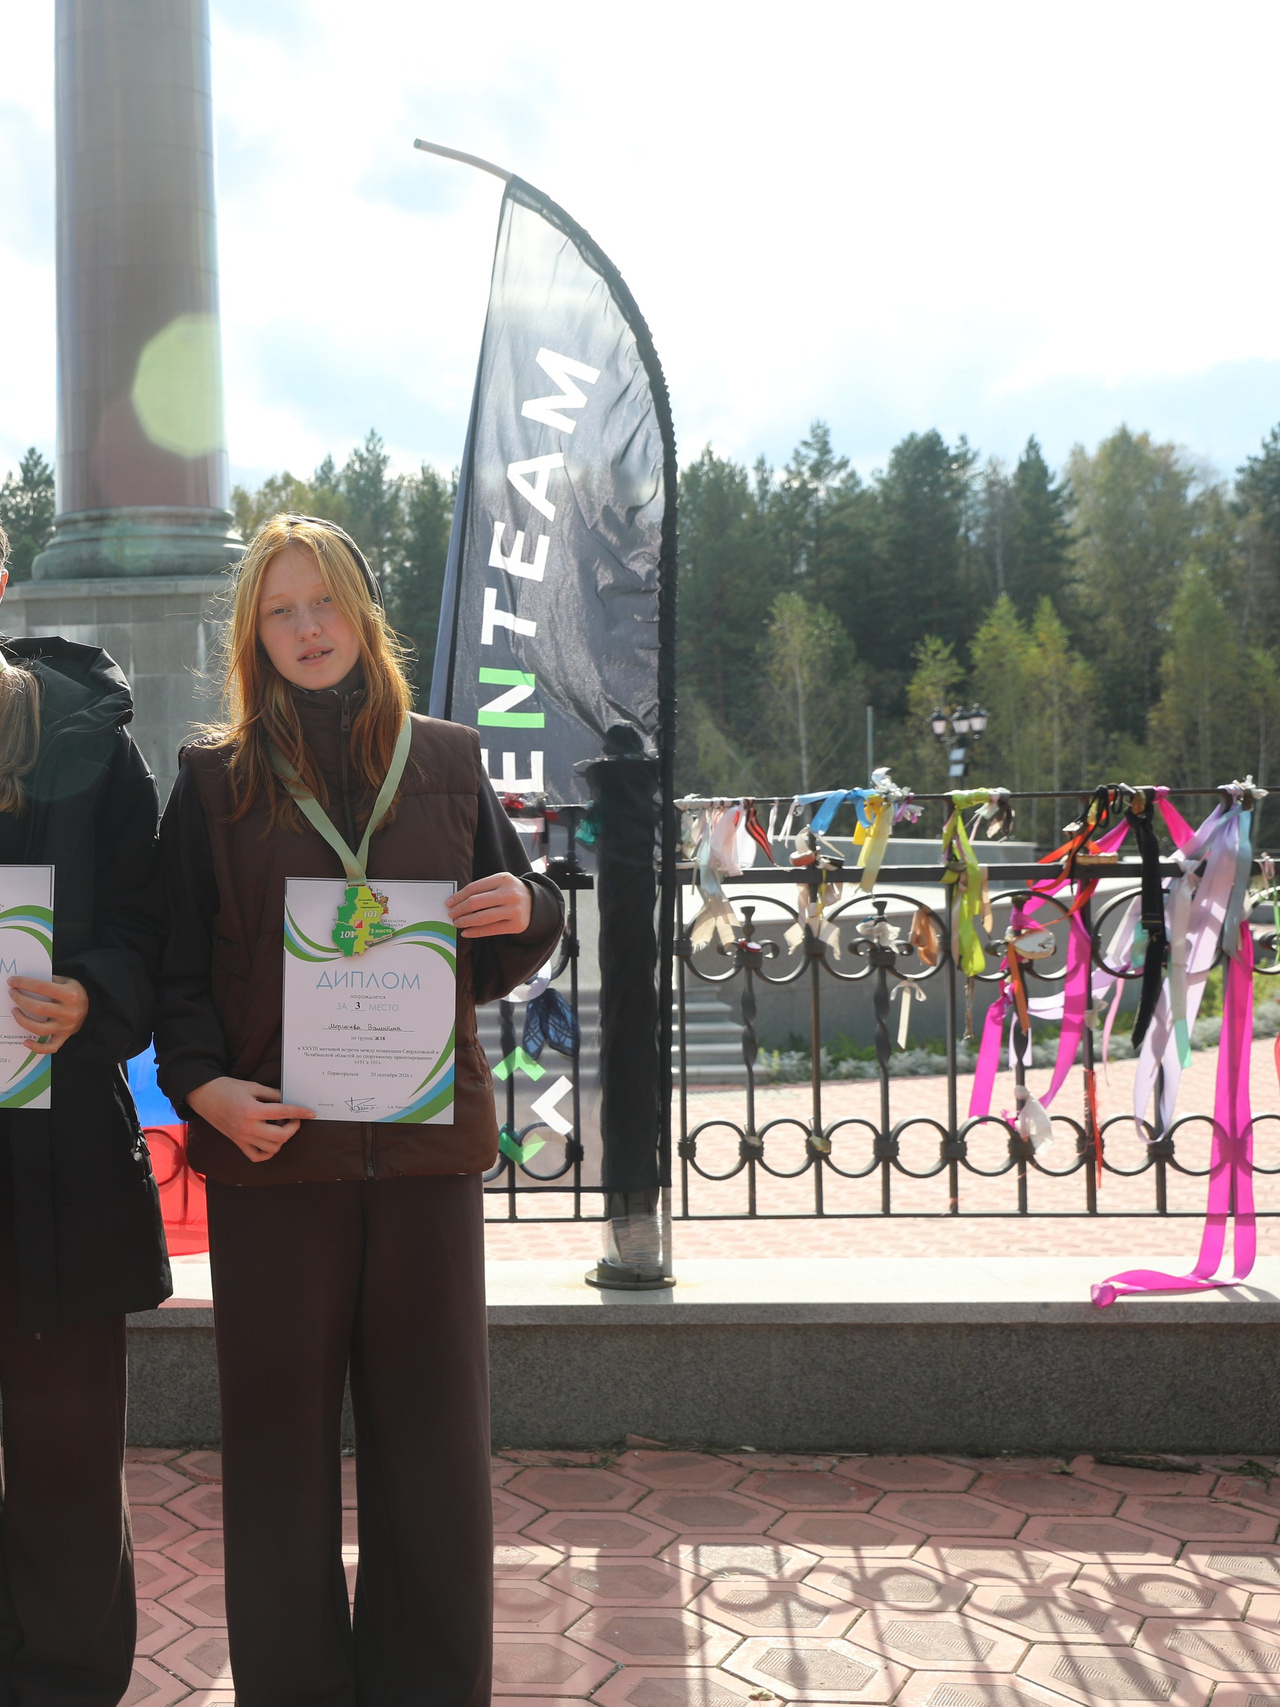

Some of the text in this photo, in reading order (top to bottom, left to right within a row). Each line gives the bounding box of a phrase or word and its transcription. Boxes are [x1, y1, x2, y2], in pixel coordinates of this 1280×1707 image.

[477, 345, 602, 872] ENTEAM
[316, 970, 420, 989] ДИПЛОМ
[355, 1001, 361, 1010] 3
